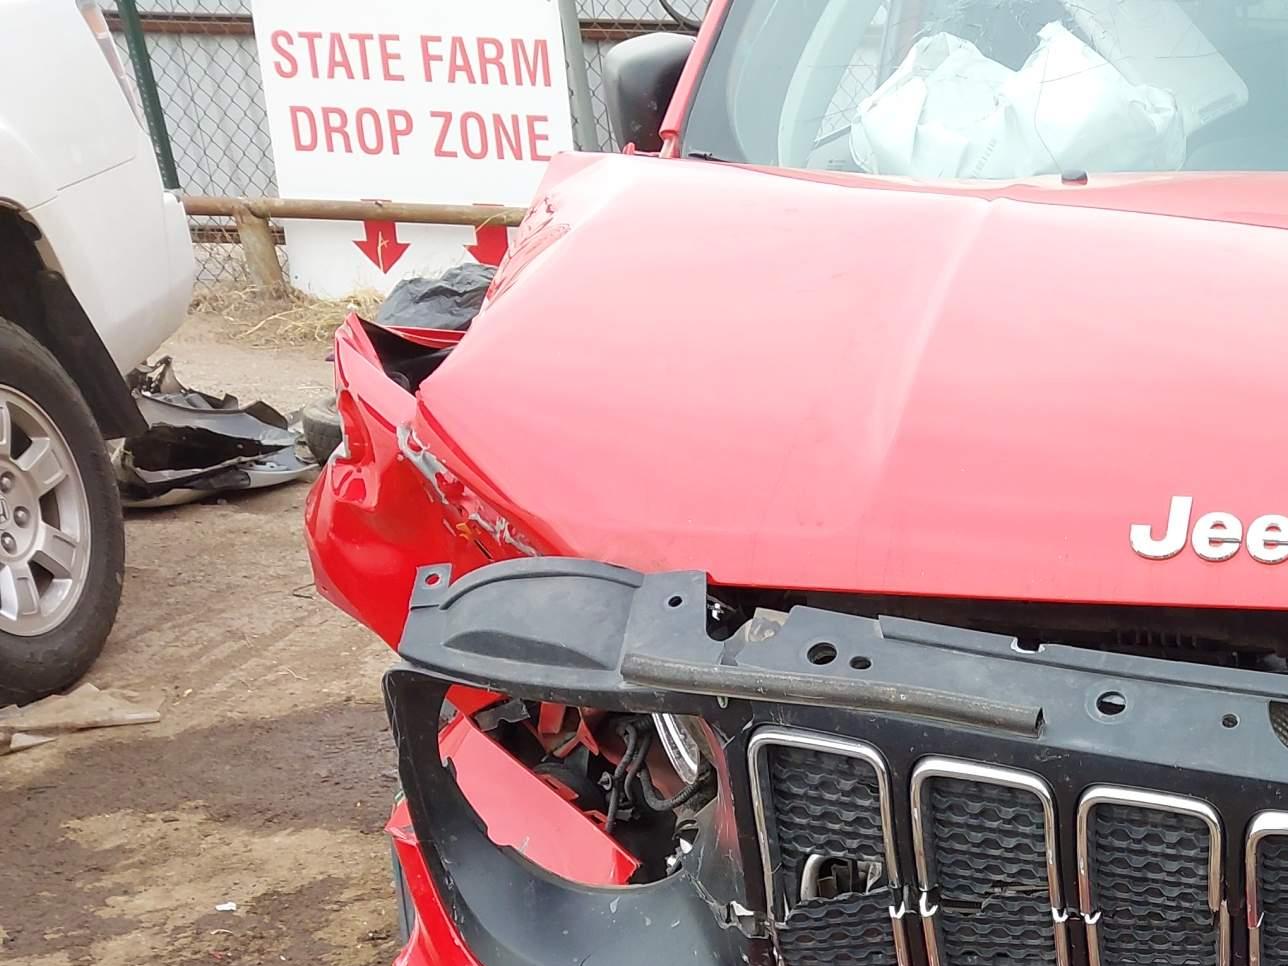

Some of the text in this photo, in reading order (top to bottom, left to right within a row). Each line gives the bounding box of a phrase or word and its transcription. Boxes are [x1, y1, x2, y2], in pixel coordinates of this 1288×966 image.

[271, 30, 551, 87] STATE FARM
[289, 105, 551, 161] DROP ZONE
